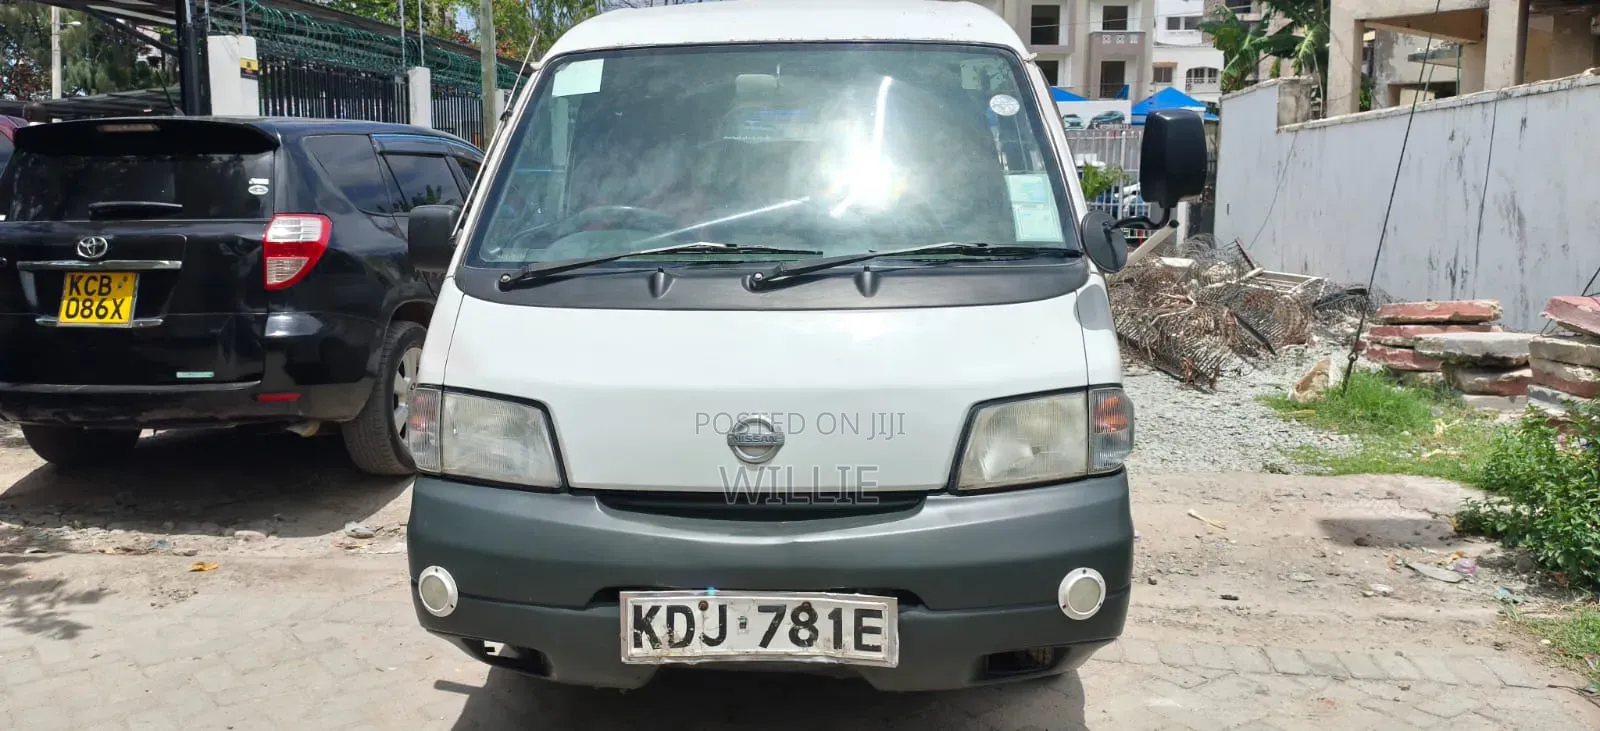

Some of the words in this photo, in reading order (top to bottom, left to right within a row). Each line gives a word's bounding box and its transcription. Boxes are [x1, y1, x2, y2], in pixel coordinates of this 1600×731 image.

[69, 274, 112, 296] KCB
[65, 297, 125, 319] 086X
[732, 435, 781, 443] NISSAN
[633, 604, 727, 649] KDJ
[757, 604, 883, 652] 781E
